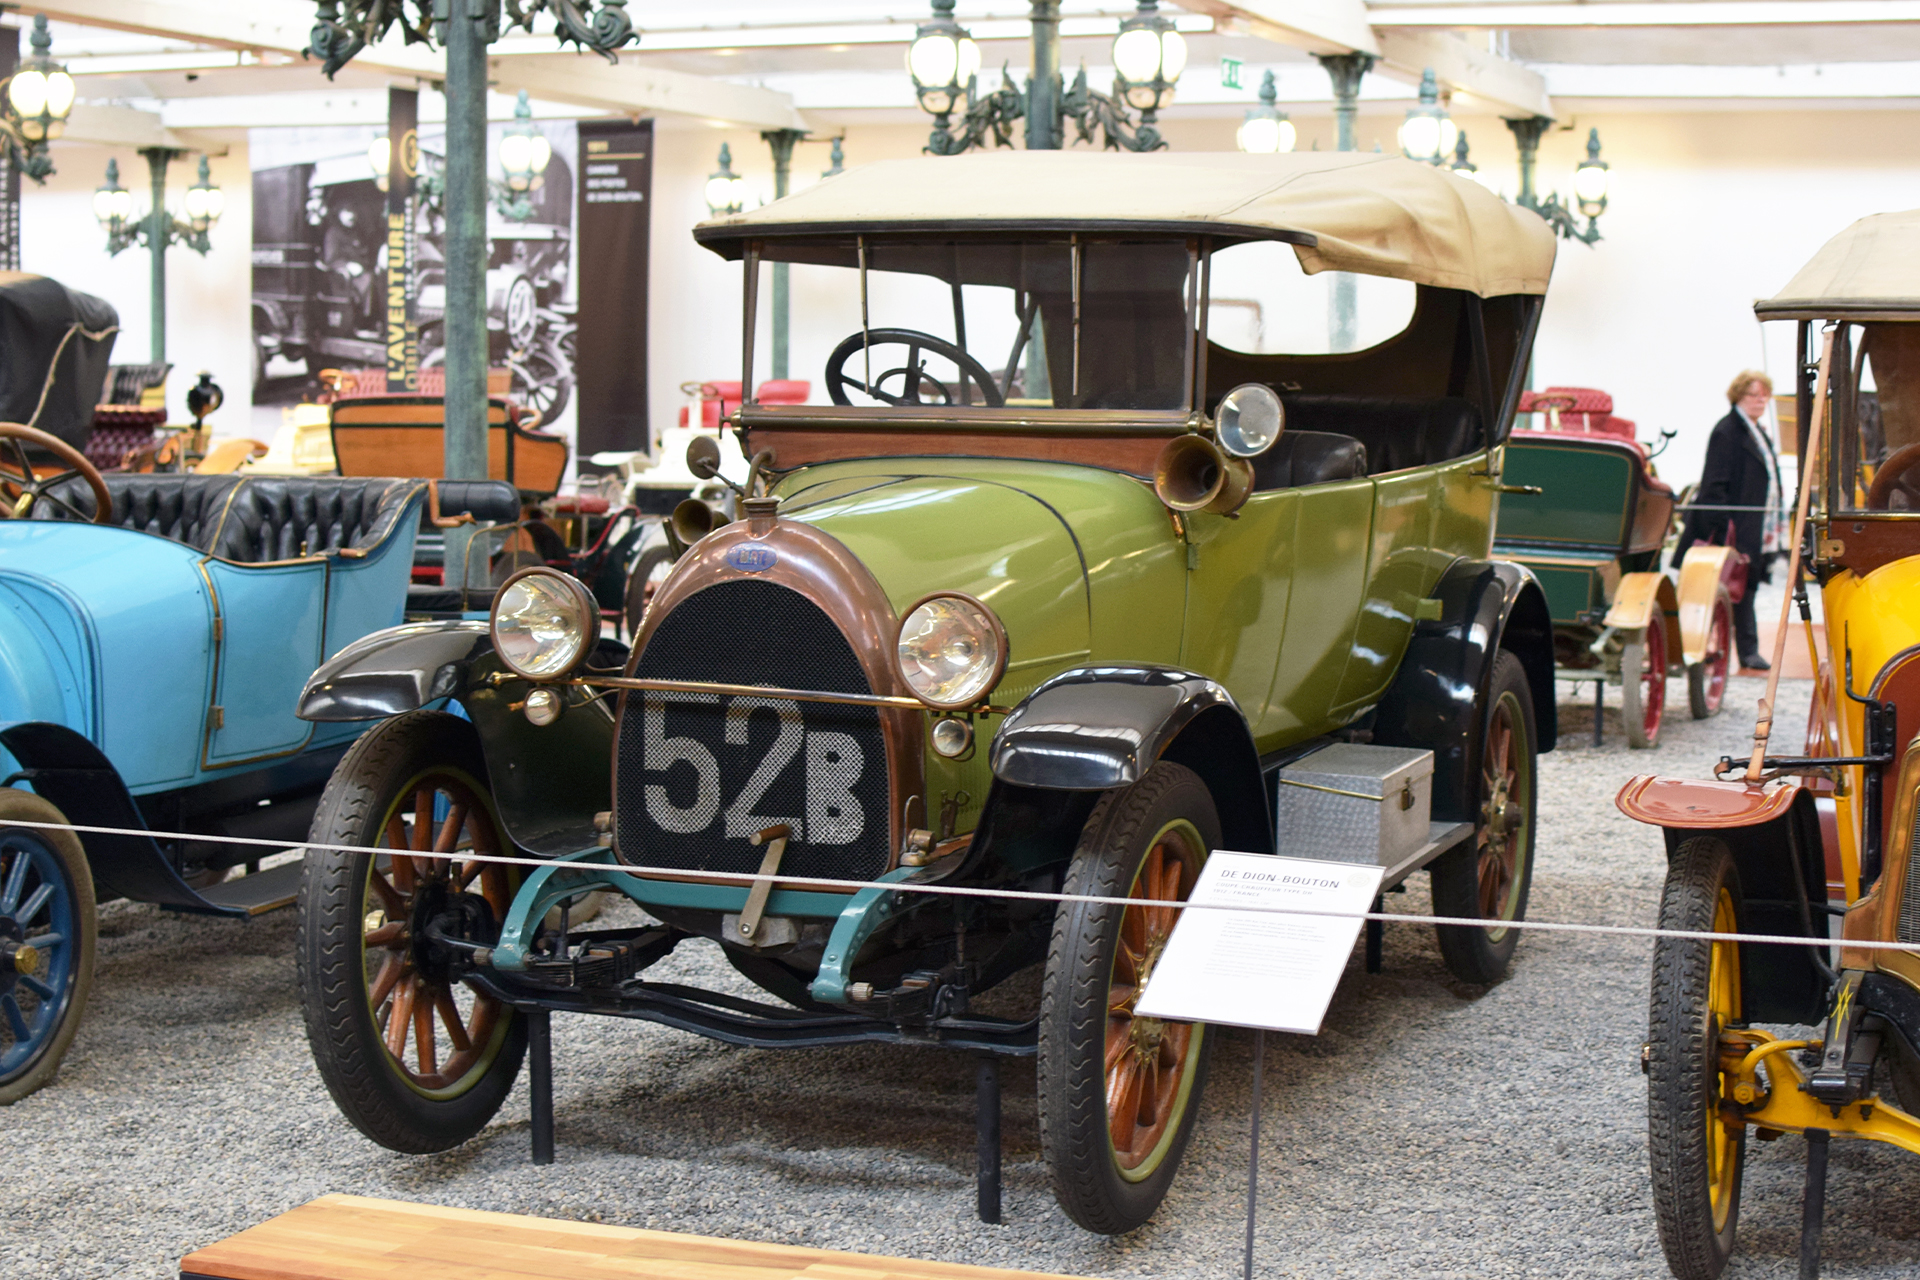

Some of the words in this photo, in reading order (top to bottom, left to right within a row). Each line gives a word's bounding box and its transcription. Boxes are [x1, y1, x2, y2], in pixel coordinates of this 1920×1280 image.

[387, 213, 406, 380] L'AVENTURE
[644, 678, 865, 846] 52B
[1220, 869, 1239, 879] DE
[1242, 871, 1340, 889] DION-BOUTON
[1233, 889, 1261, 897] FRANCE
